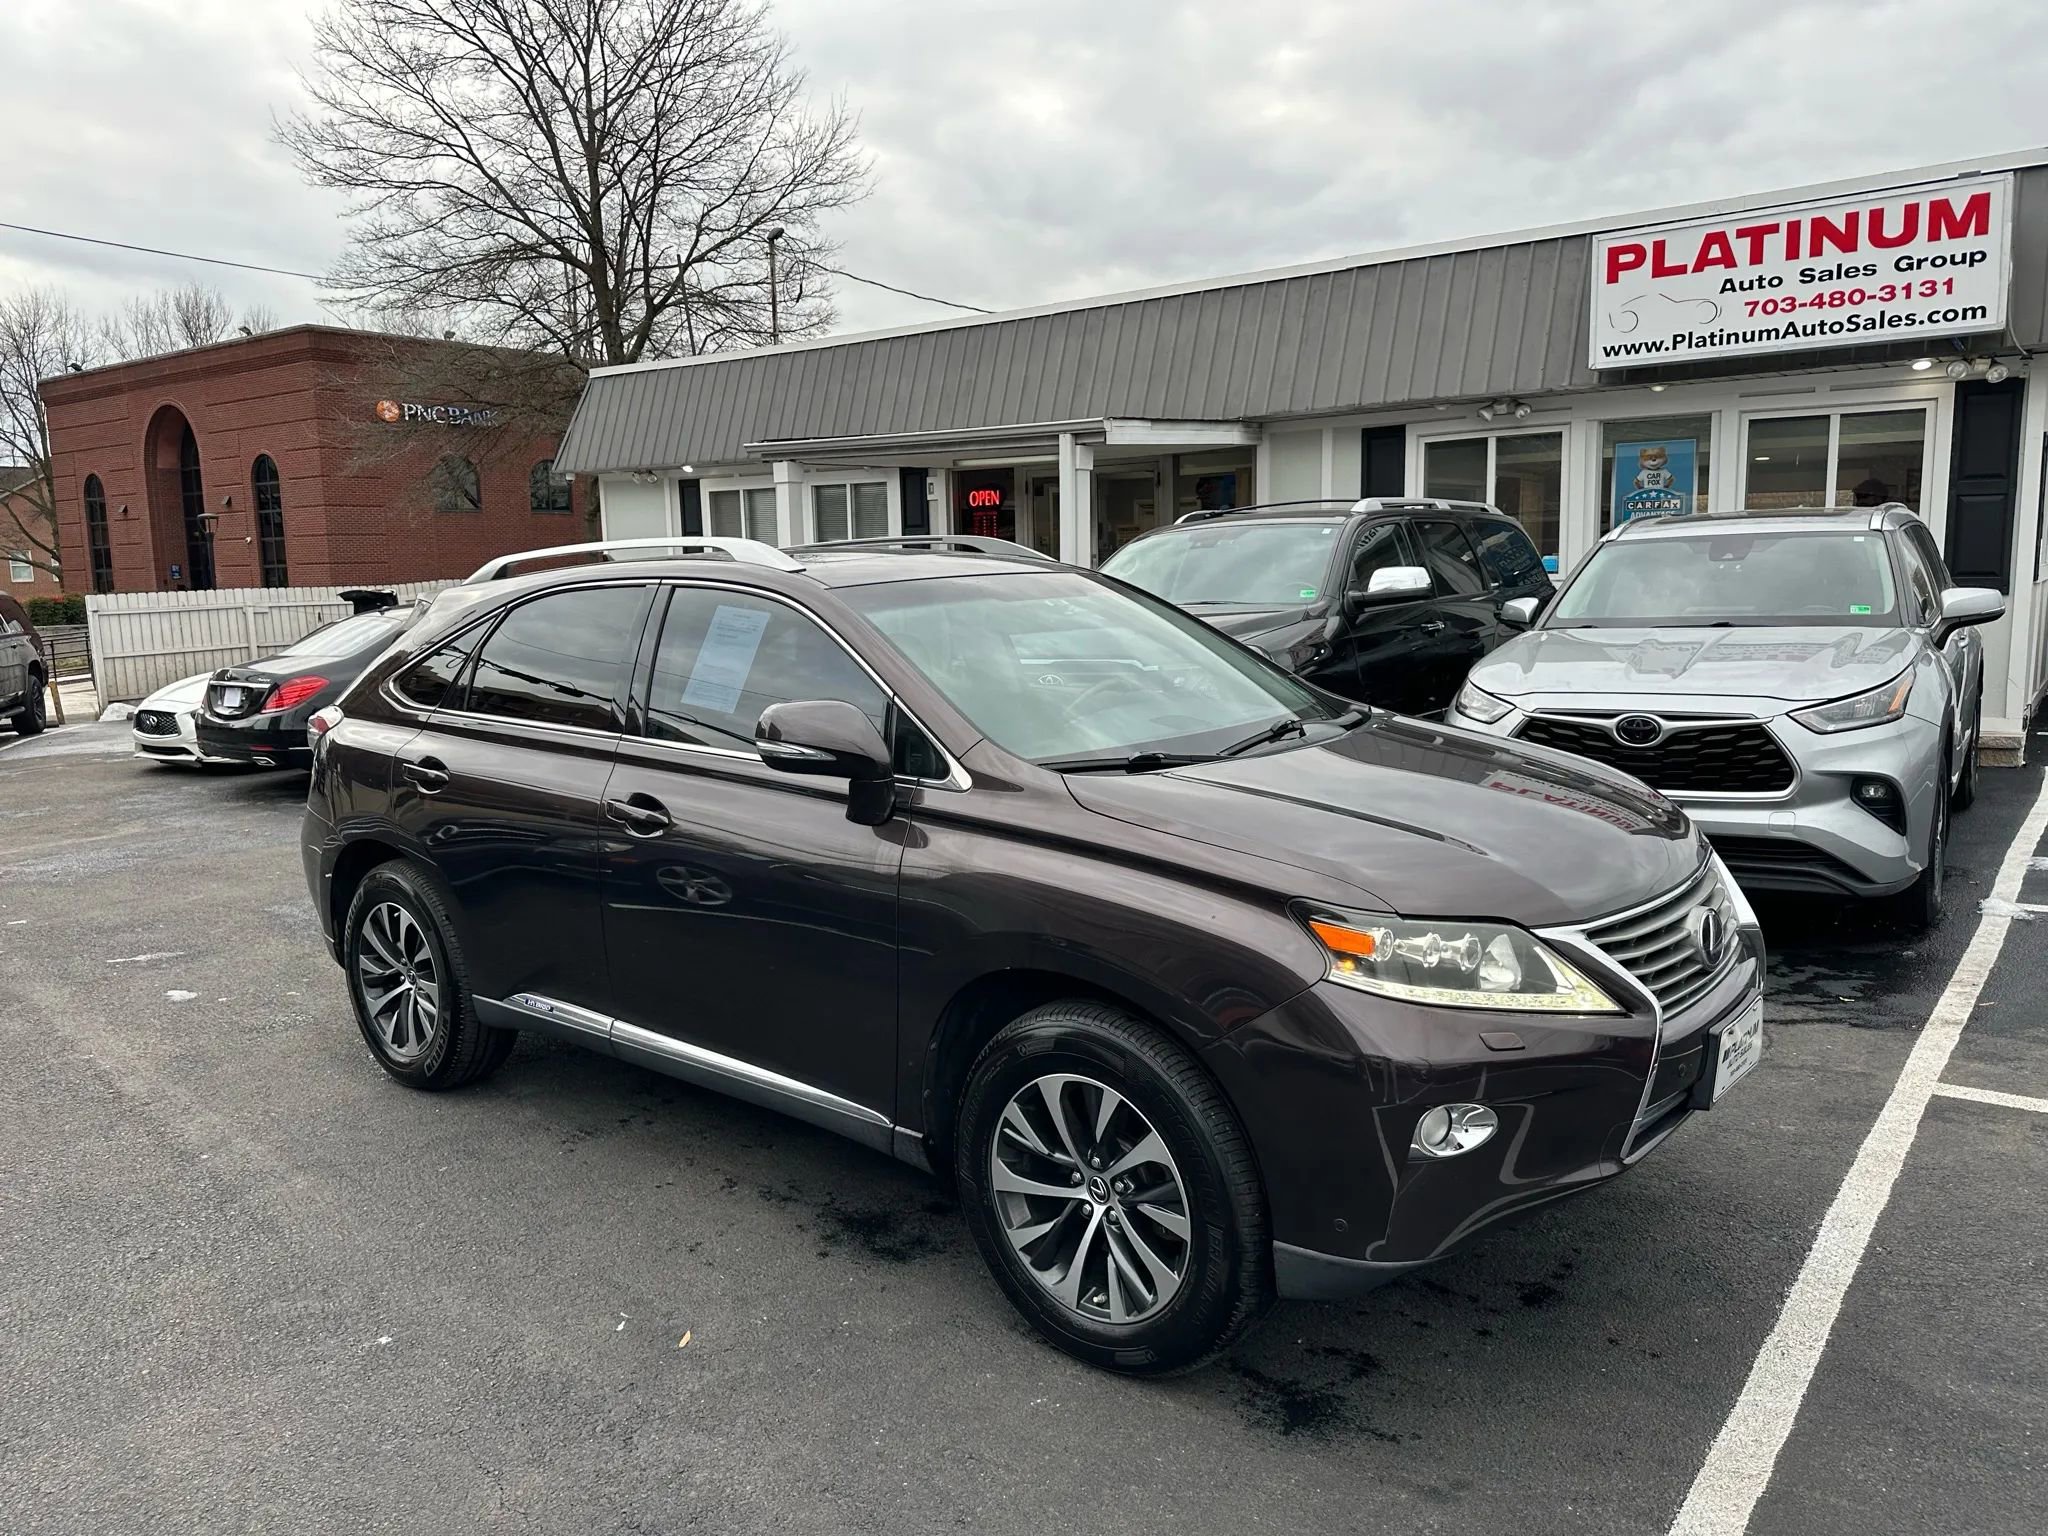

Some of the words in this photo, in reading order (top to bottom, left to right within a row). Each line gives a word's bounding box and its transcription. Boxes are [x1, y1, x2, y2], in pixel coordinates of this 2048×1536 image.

[1605, 191, 1992, 285] PLATINUM
[1719, 273, 1784, 296] Auto
[1798, 259, 1878, 285] Sales
[1893, 248, 1988, 274] Group
[1744, 277, 1955, 318] 703-480-3131
[1602, 302, 1988, 359] www.PlatinumAutoSales.com
[1646, 472, 1661, 480] CAR
[969, 489, 1000, 507] OPEN
[1627, 501, 1680, 510] CARFAX
